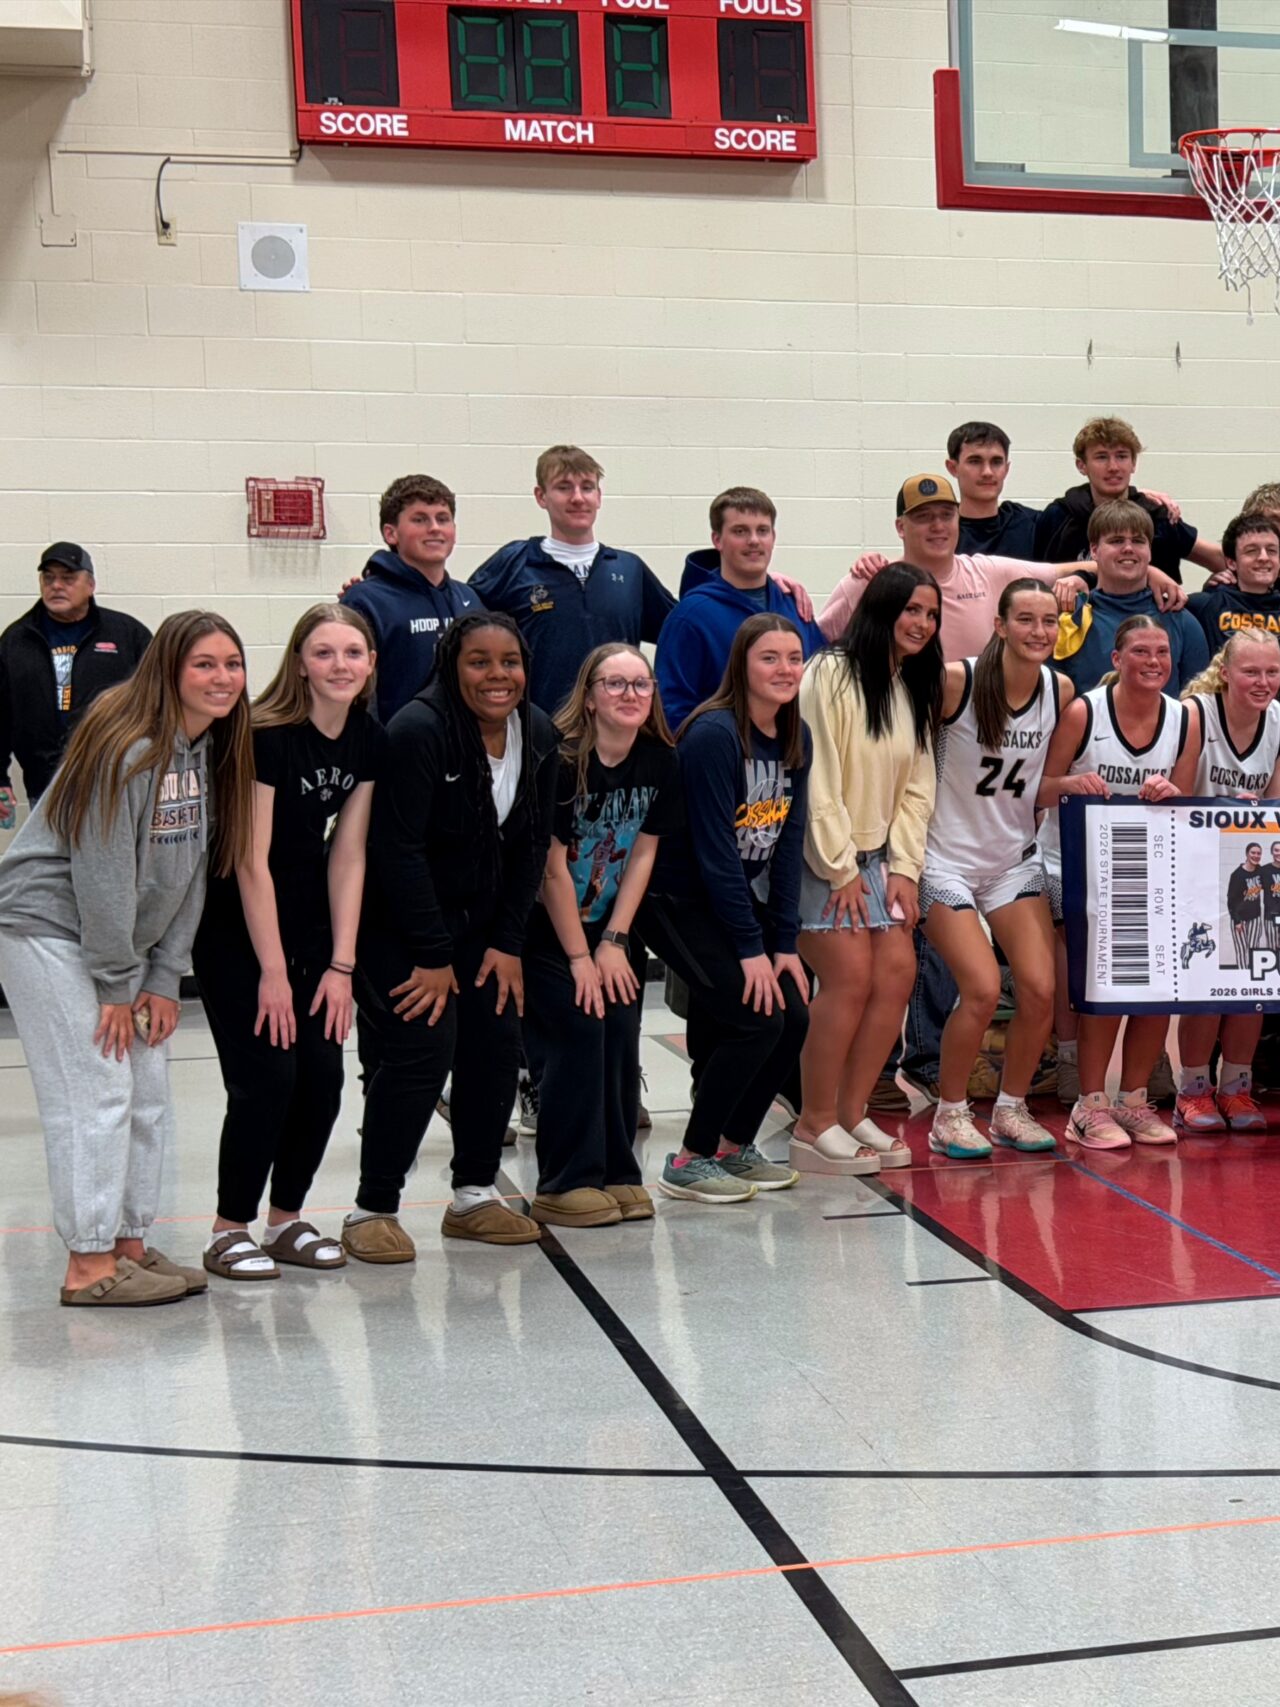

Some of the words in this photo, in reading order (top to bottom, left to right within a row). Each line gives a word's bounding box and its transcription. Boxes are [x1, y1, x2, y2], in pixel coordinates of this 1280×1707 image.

[719, 0, 804, 17] FOULS
[320, 112, 409, 137] SCORE
[504, 119, 595, 145] MATCH
[714, 128, 798, 152] SCORE
[410, 619, 440, 634] HOOP
[300, 766, 354, 795] AERO
[975, 756, 1026, 798] 24
[1209, 765, 1269, 790] COSSACKS
[1188, 810, 1267, 829] SIOUX
[1099, 823, 1109, 856] 2026
[1153, 834, 1164, 859] SEC
[1099, 861, 1109, 899] STATE
[1154, 887, 1164, 916] ROW
[1097, 903, 1108, 987] TOURNAMENT
[1155, 944, 1166, 976] SEAT
[1210, 988, 1237, 996] 2026
[1240, 987, 1273, 996] GIRLS
